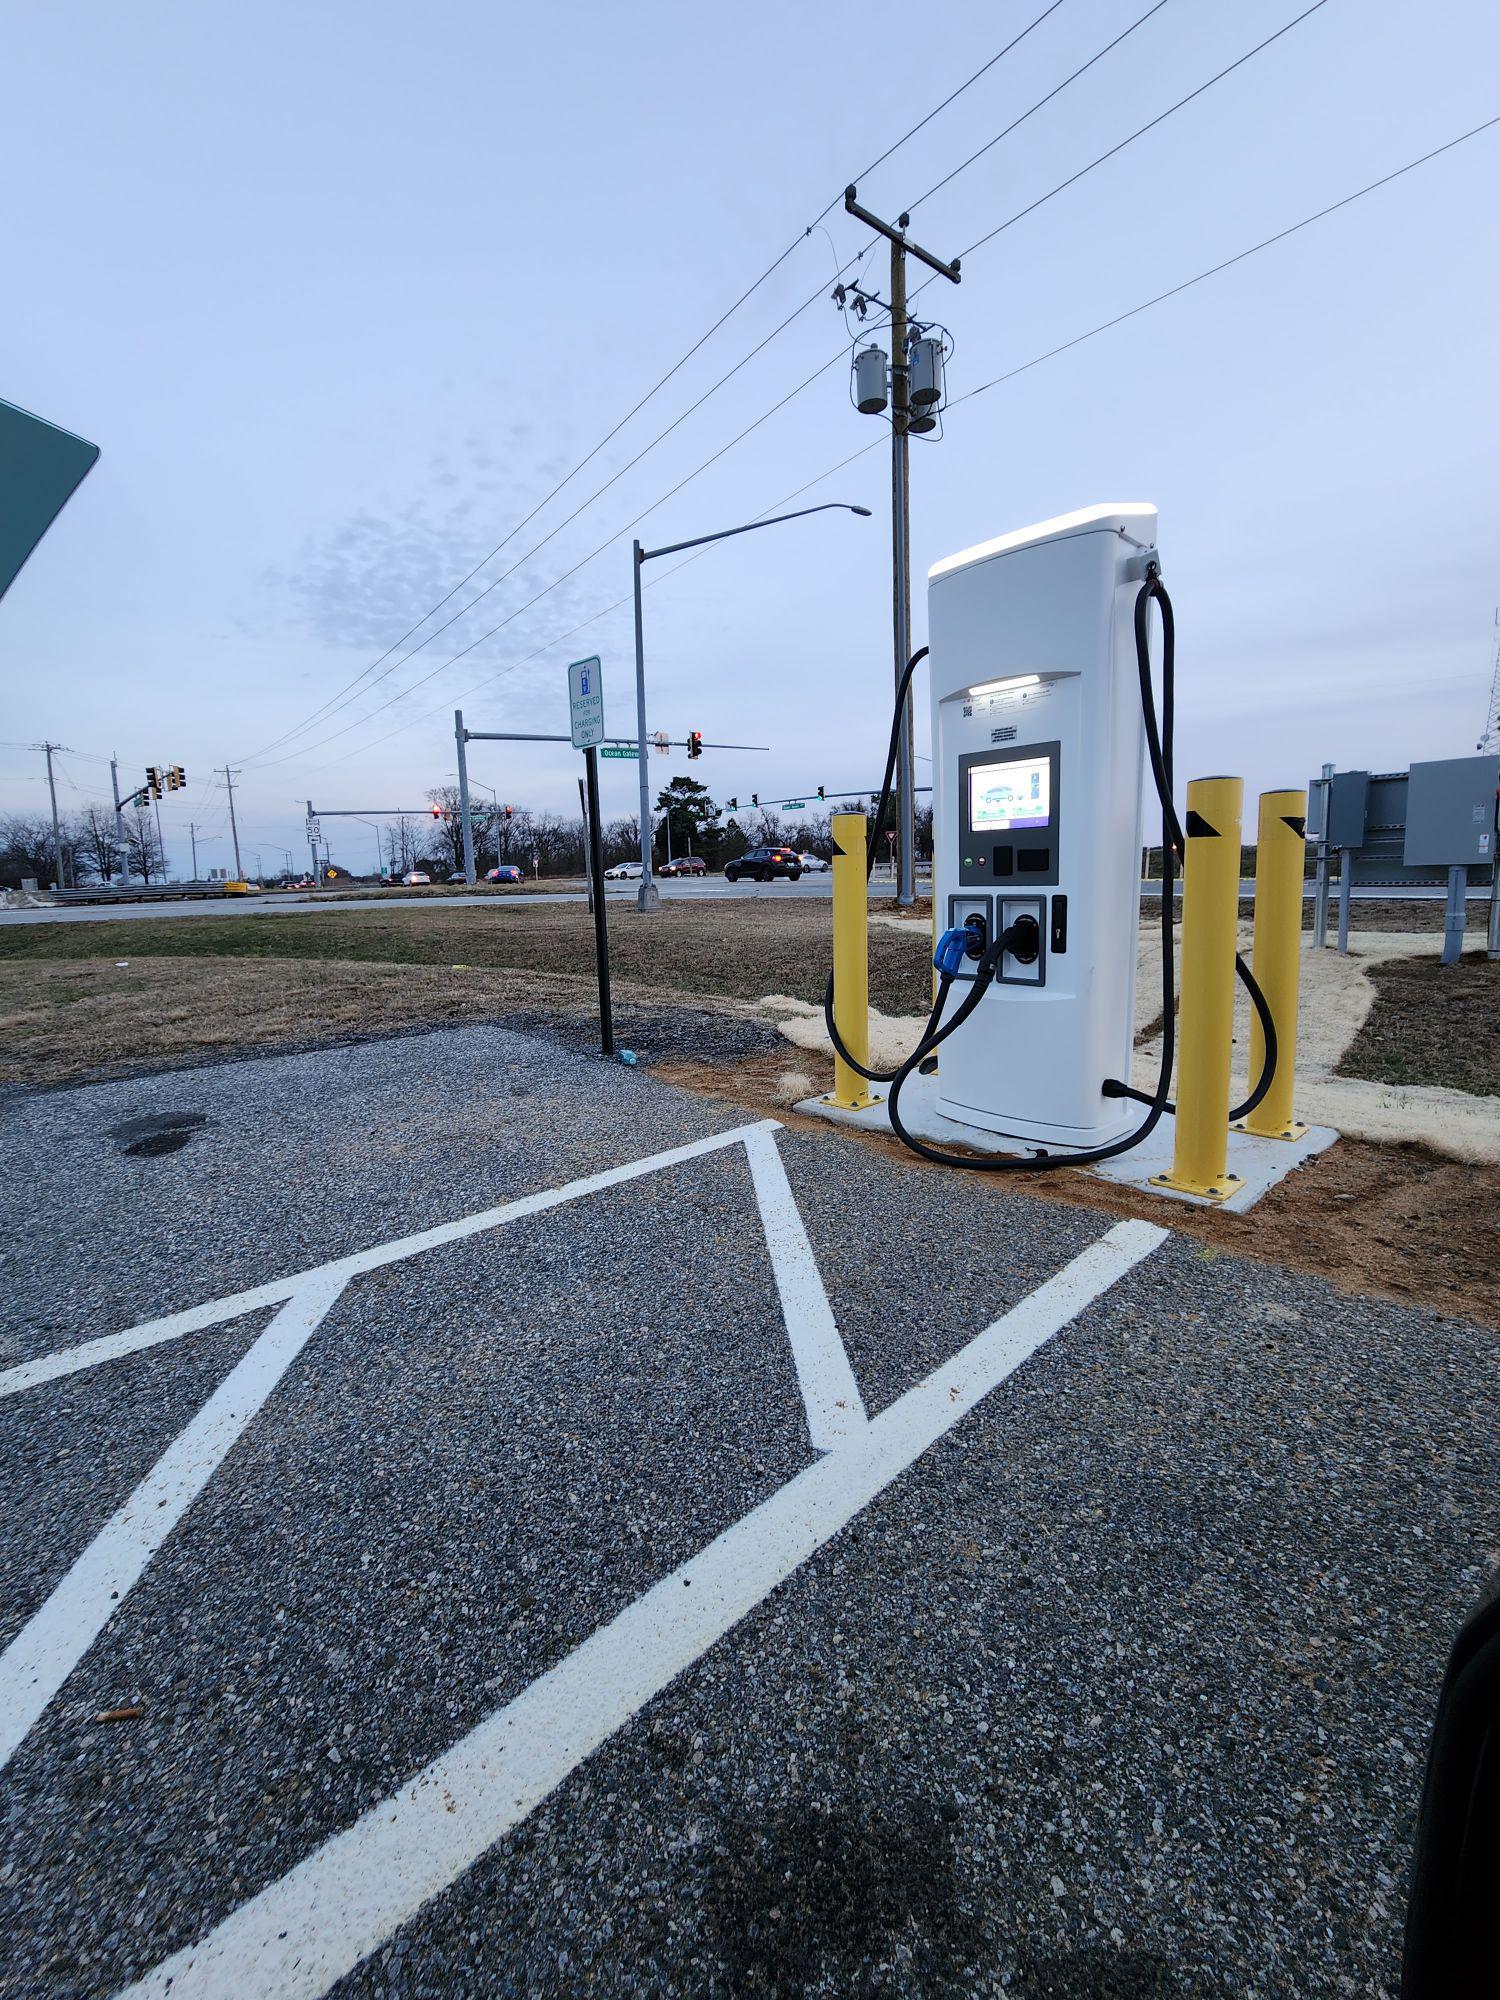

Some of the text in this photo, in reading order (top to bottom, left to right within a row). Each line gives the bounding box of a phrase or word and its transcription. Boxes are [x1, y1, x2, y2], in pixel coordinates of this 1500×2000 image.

[573, 696, 600, 710] RESERVED
[574, 716, 600, 729] CHARGING
[581, 728, 595, 738] ONLY
[604, 749, 621, 757] Ocean
